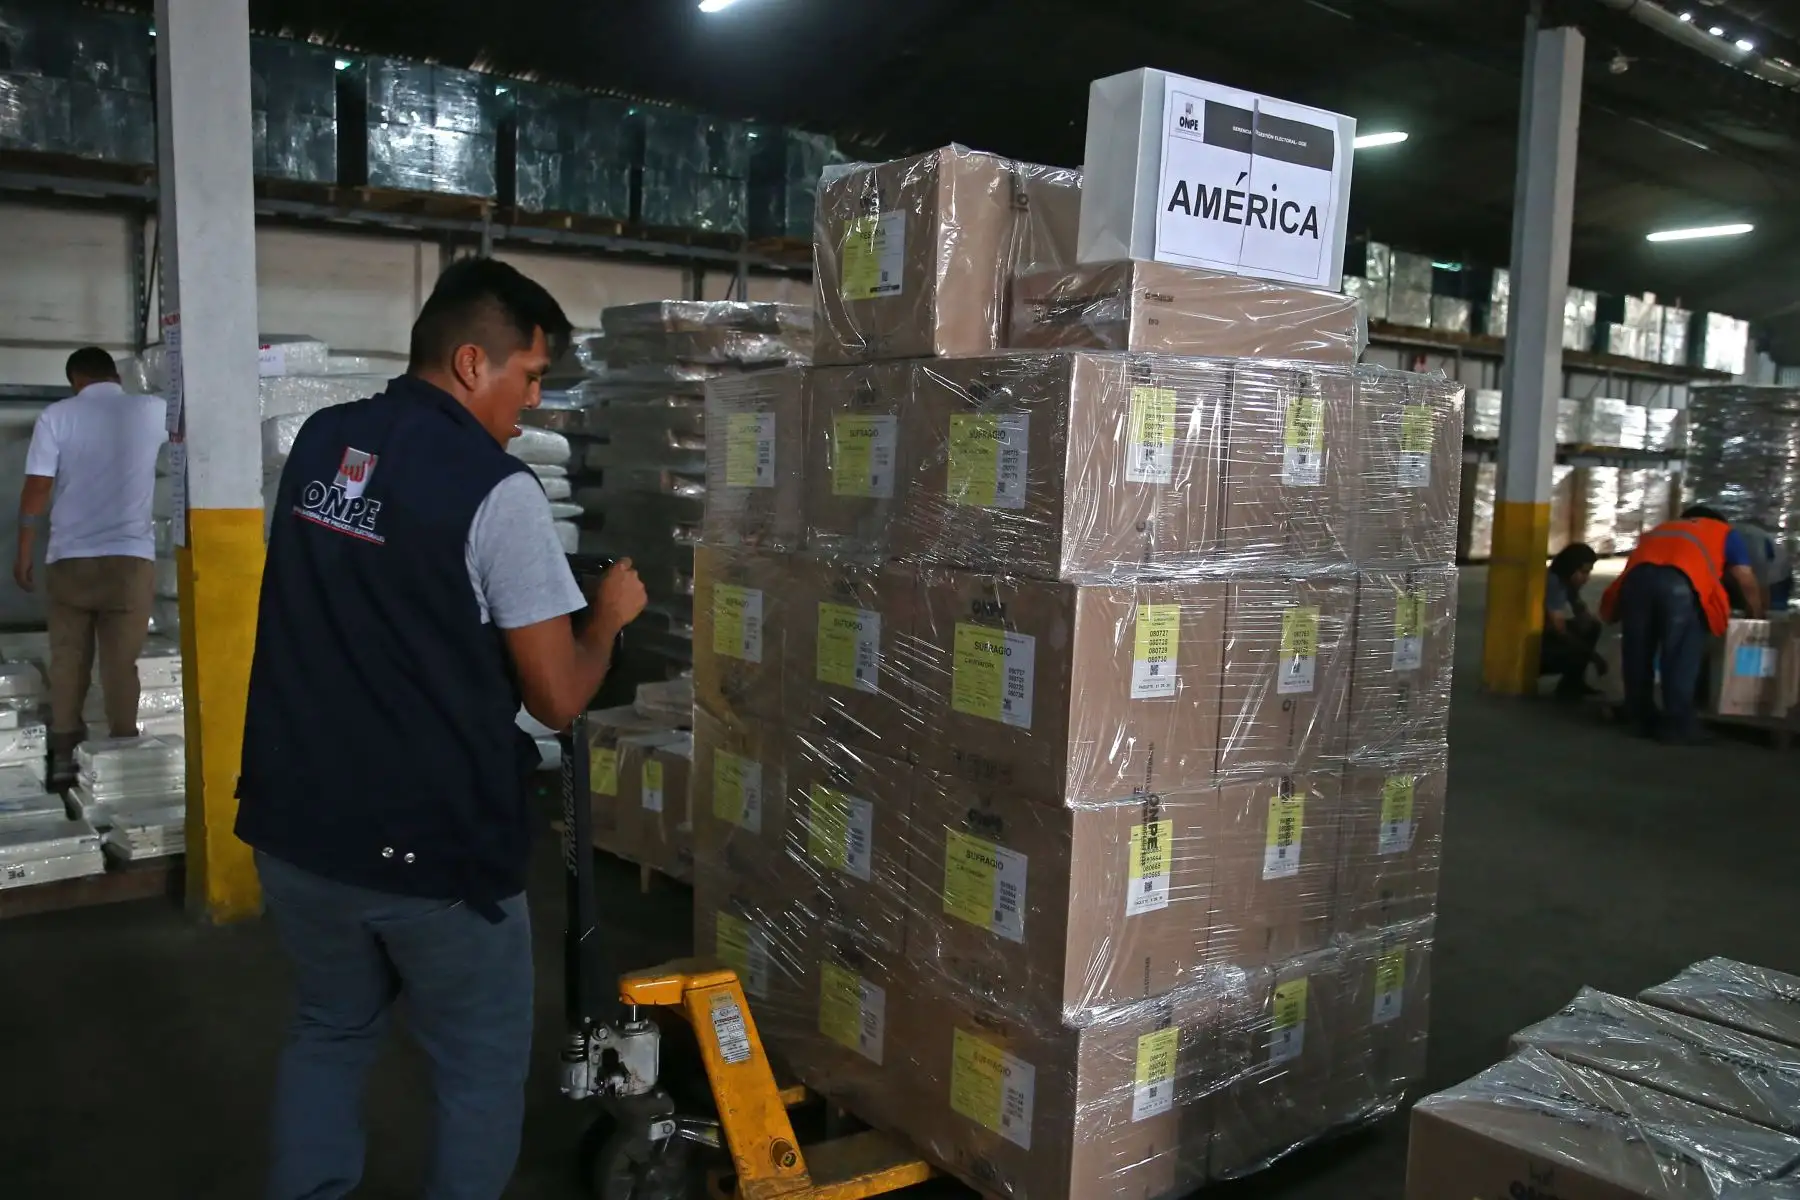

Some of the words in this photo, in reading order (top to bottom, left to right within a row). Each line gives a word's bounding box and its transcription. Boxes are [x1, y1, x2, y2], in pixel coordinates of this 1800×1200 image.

[1179, 116, 1199, 131] ONPE
[303, 480, 382, 531] ONPE
[1149, 630, 1169, 638] 080727
[974, 641, 1012, 657] SUFRAGIO
[1148, 794, 1160, 850] ONPE
[965, 849, 1004, 871] SUFRAGIO
